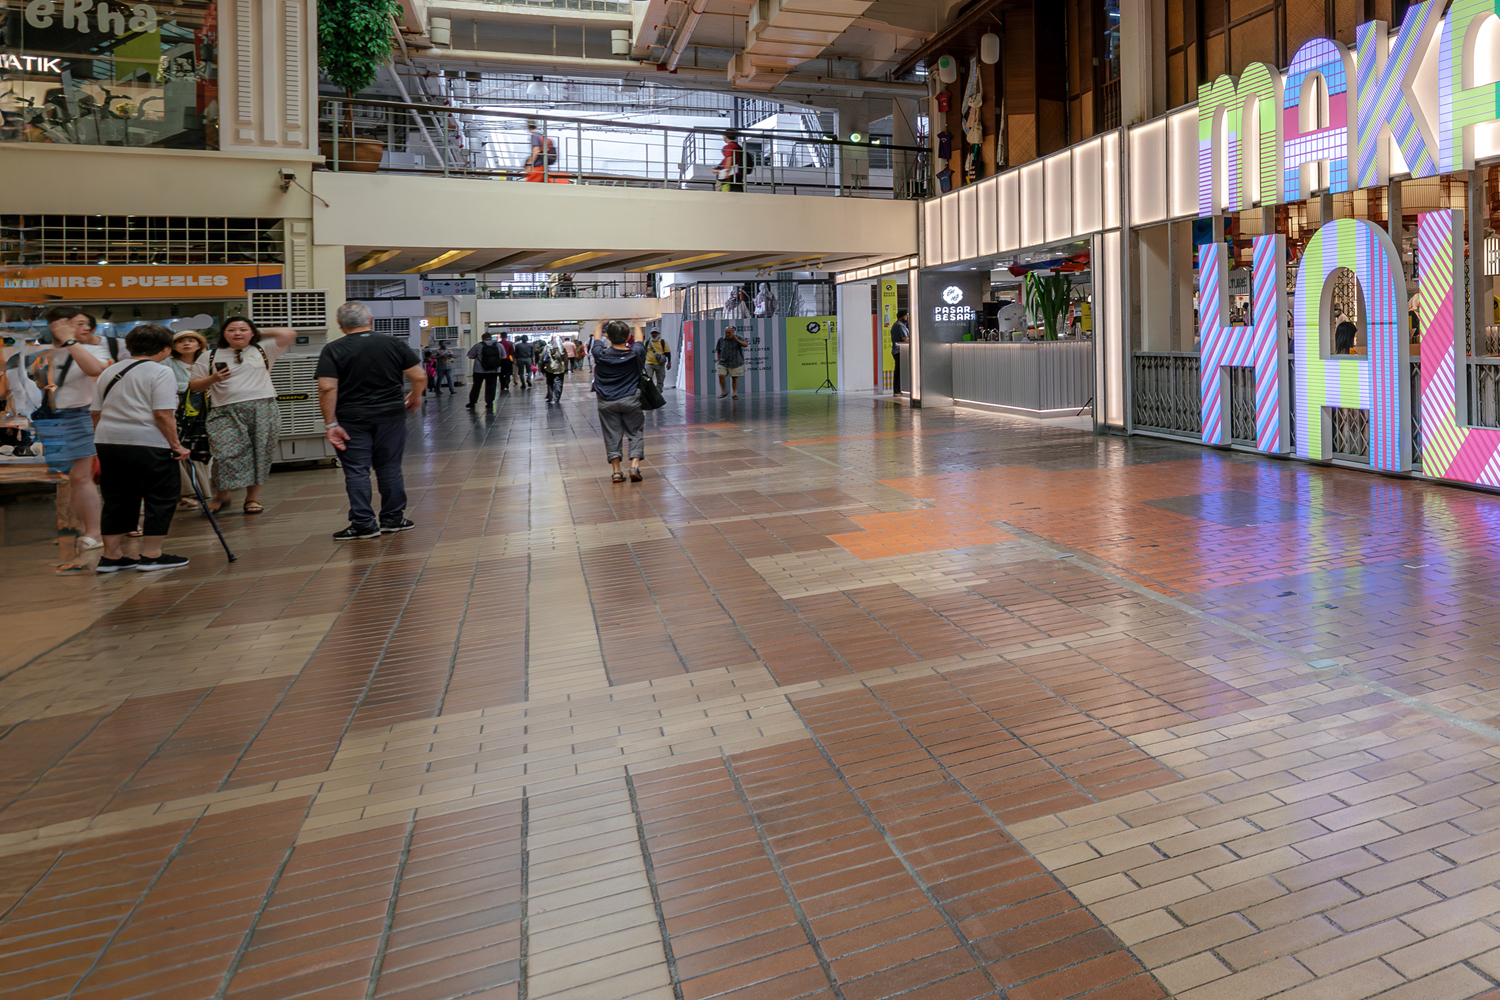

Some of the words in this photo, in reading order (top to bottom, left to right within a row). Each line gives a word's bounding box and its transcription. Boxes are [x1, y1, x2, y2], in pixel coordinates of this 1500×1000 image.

[122, 275, 228, 287] PUZZLES
[935, 305, 970, 313] PASAR
[935, 313, 970, 321] BESAR
